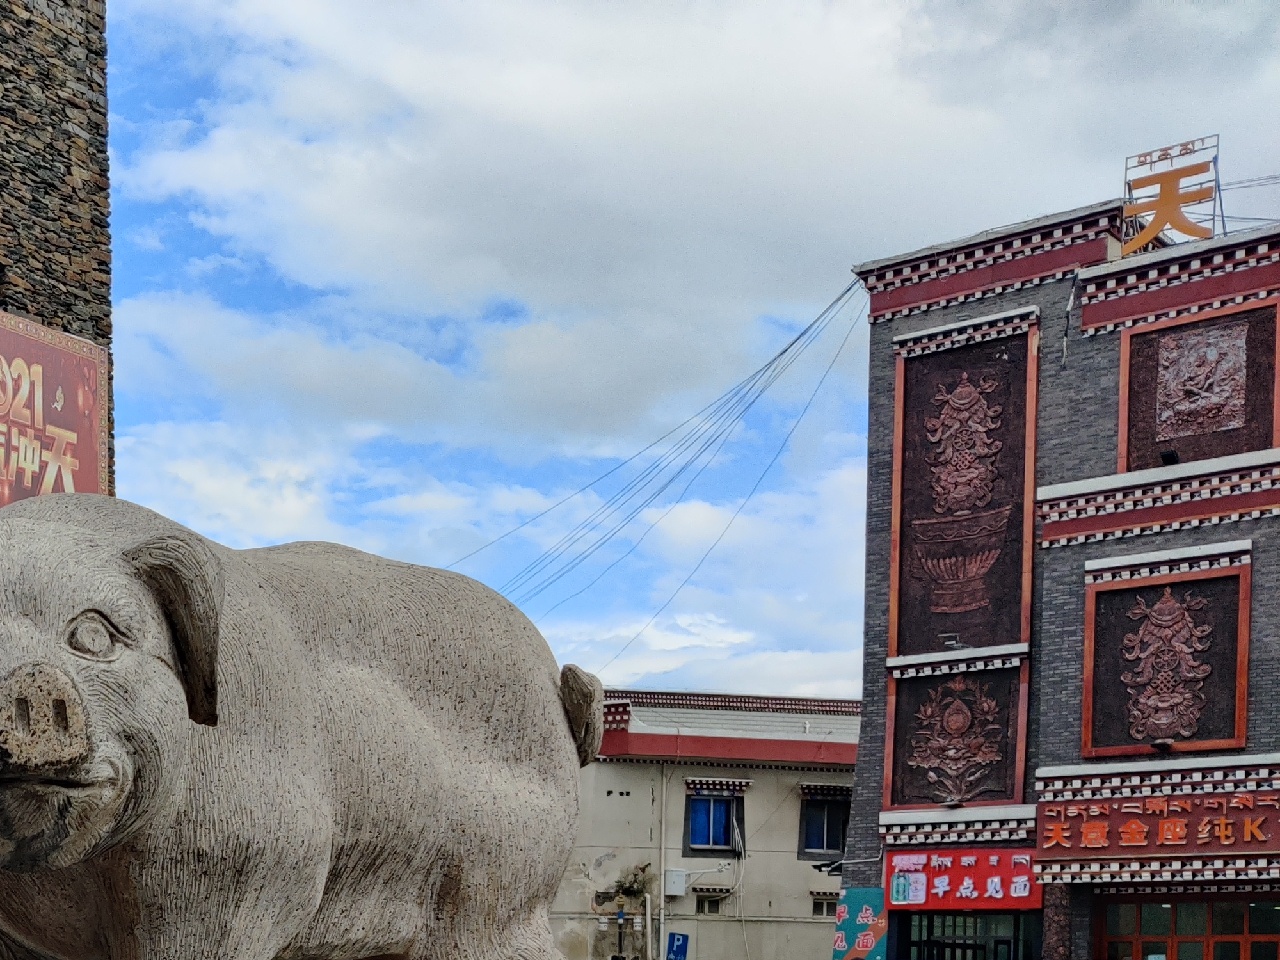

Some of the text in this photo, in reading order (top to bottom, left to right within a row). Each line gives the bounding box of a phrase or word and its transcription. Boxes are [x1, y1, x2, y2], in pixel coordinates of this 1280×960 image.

[1122, 161, 1214, 256] 天
[1042, 816, 1268, 849] 天意金座纯K
[931, 875, 1031, 899] 早点见面
